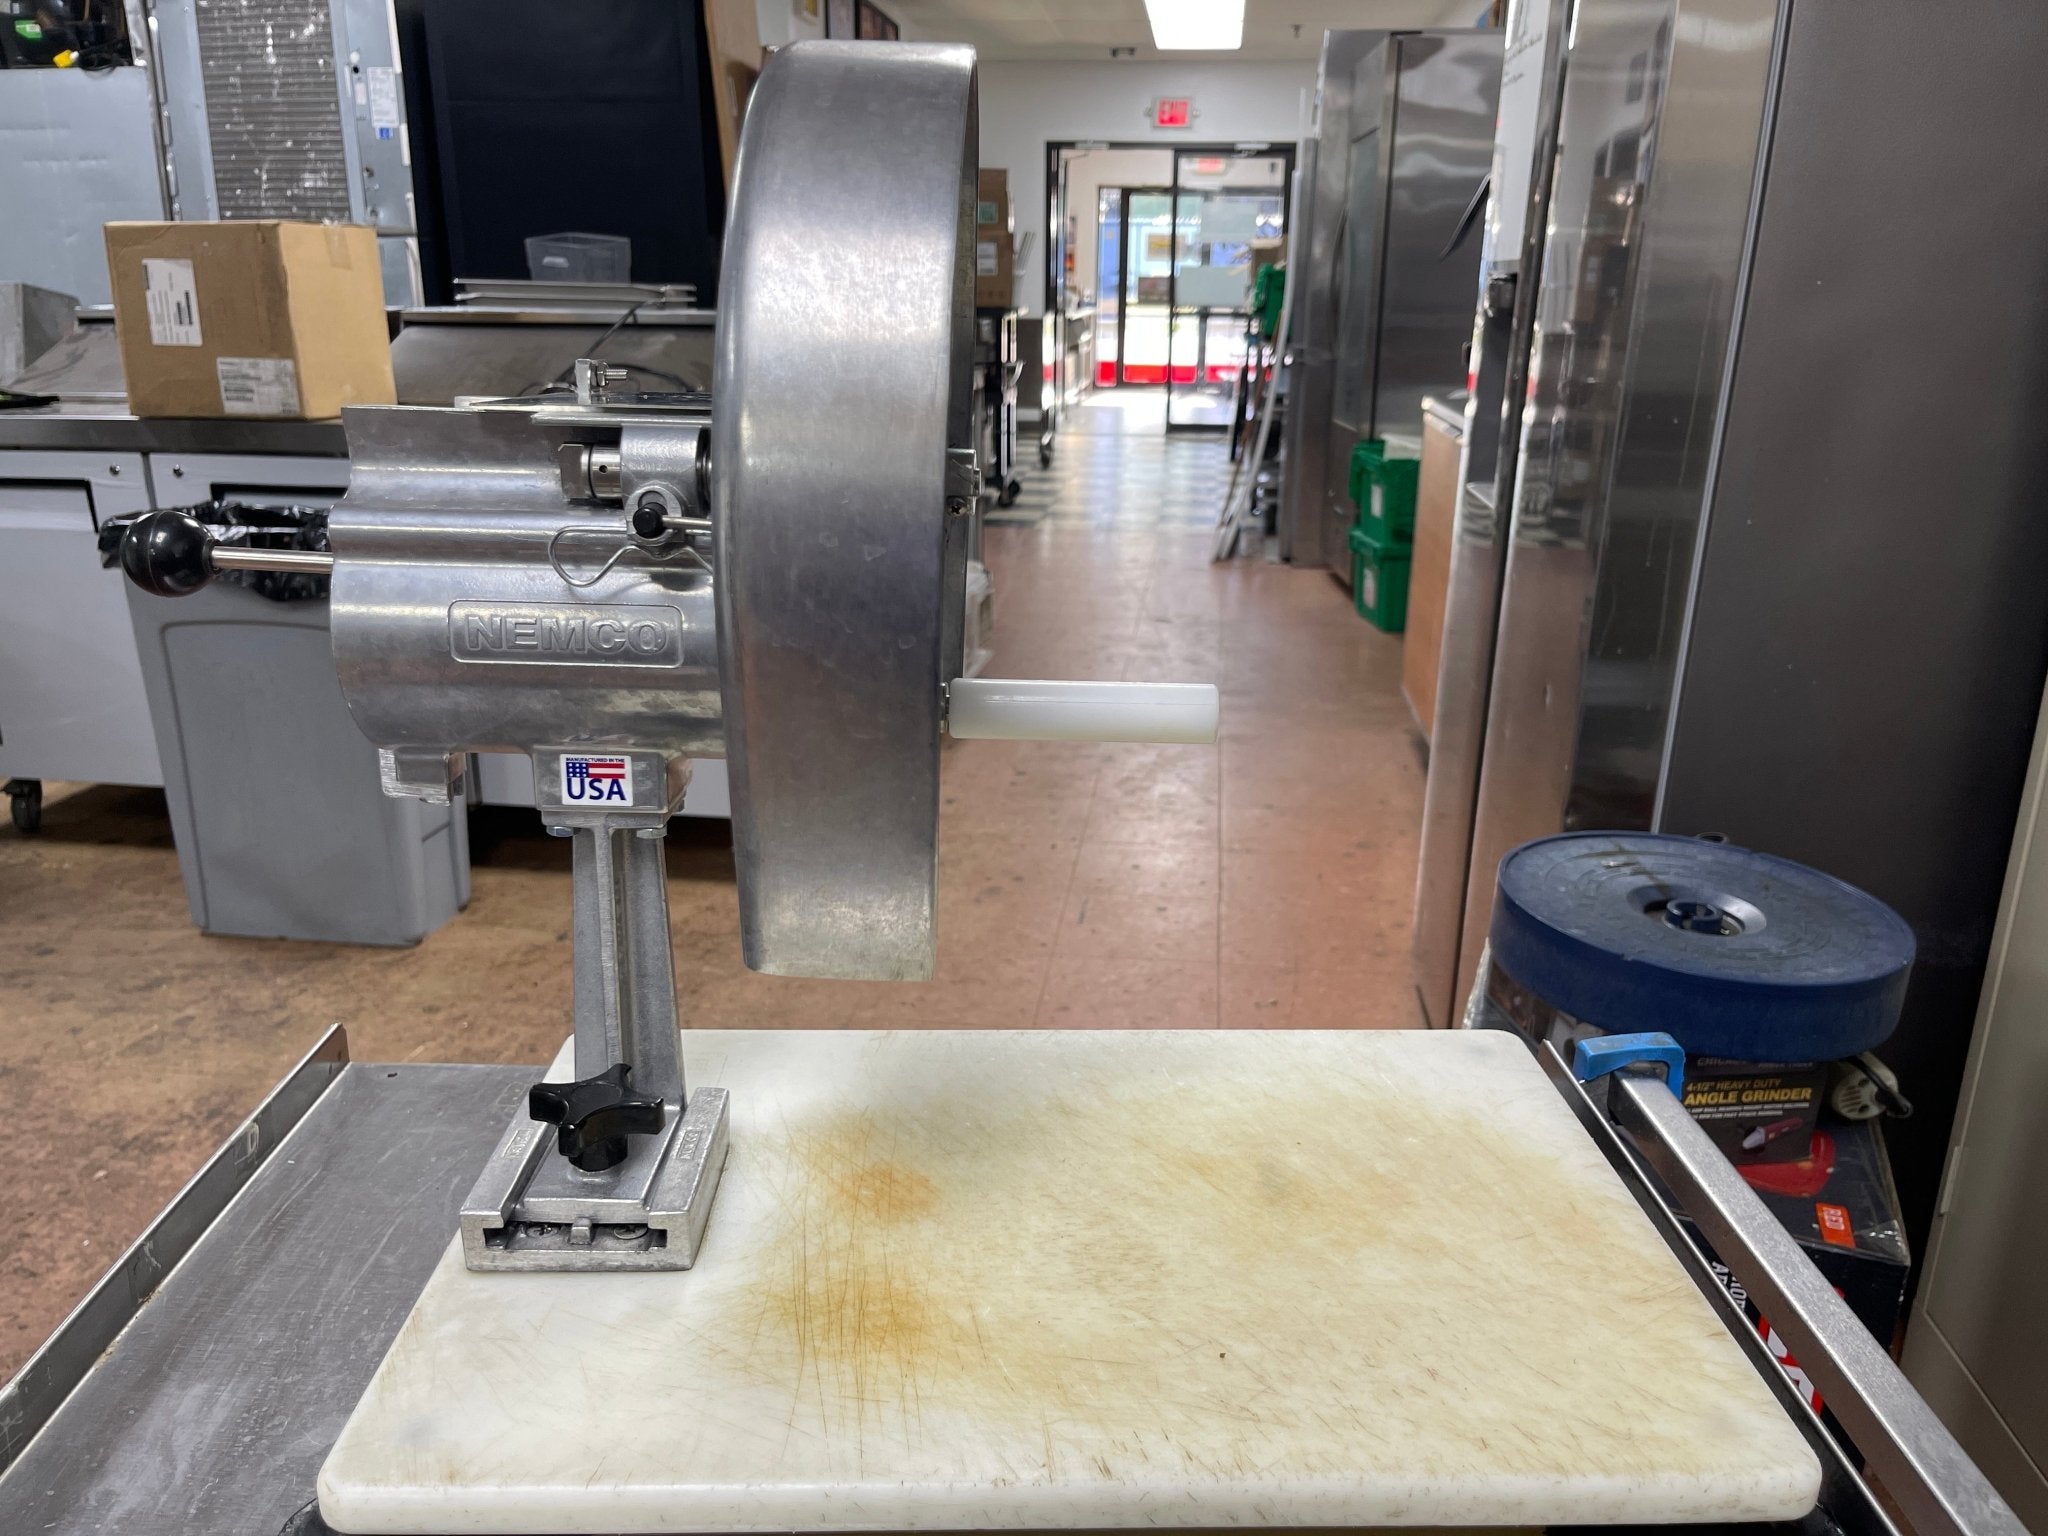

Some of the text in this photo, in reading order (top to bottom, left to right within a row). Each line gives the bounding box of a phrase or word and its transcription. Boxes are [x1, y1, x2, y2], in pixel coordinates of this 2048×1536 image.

[466, 616, 667, 654] NEMCO
[567, 778, 626, 800] USA
[1716, 1080, 1751, 1090] HEAVY
[1753, 1079, 1781, 1089] DUTY
[1684, 1087, 1812, 1106] ANGLE GRINDER
